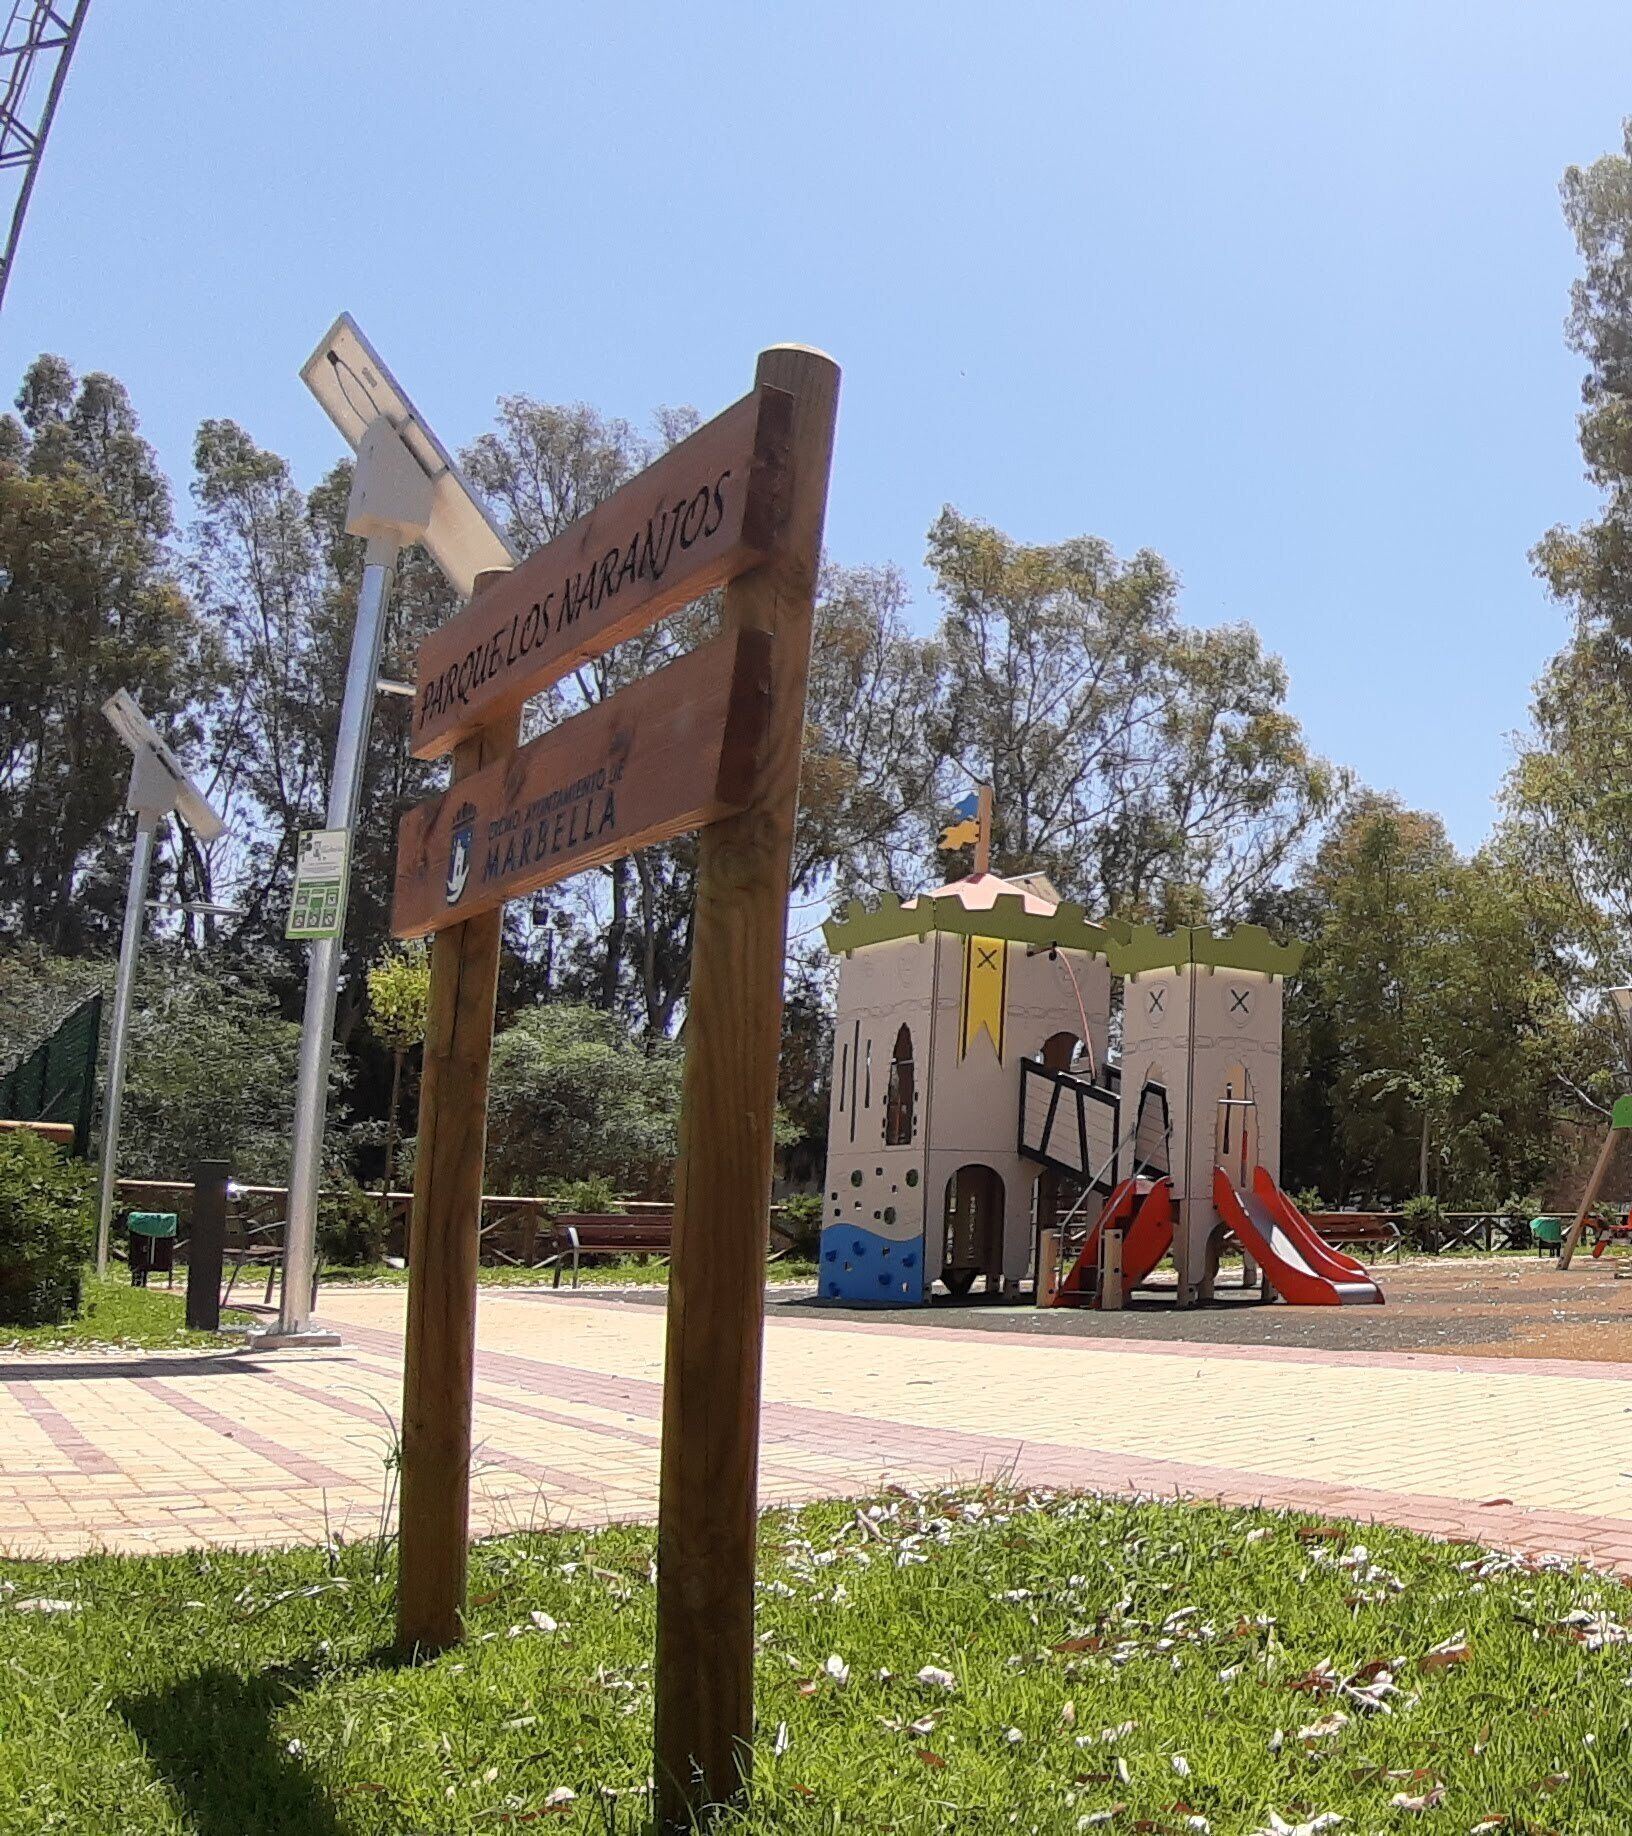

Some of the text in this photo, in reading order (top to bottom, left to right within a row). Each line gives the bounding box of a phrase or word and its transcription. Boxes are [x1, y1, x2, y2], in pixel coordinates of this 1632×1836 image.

[419, 469, 732, 729] PARQUE LOS NARANJOS
[484, 791, 615, 881] MARBELLA
